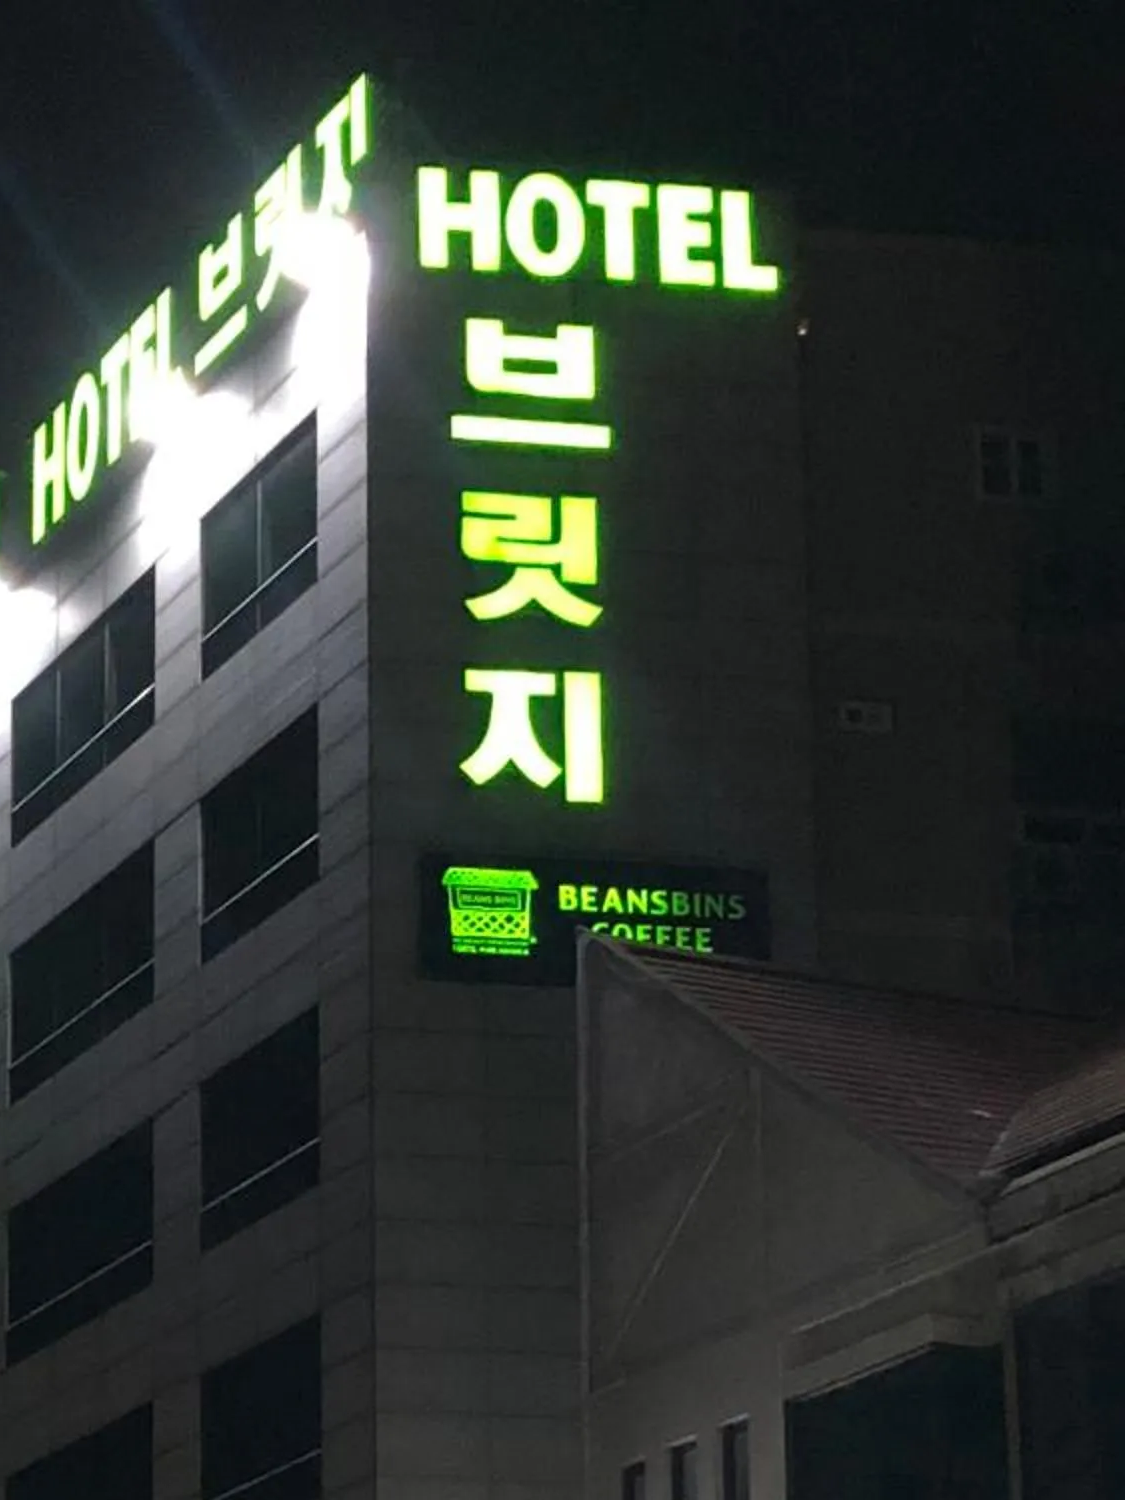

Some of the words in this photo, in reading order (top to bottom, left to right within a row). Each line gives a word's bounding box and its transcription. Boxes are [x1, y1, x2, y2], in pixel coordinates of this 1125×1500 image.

[417, 166, 780, 293] HOTEL
[32, 286, 183, 544] HOTEL
[450, 318, 612, 804] 브릿지
[558, 884, 746, 920] BEANSBINS
